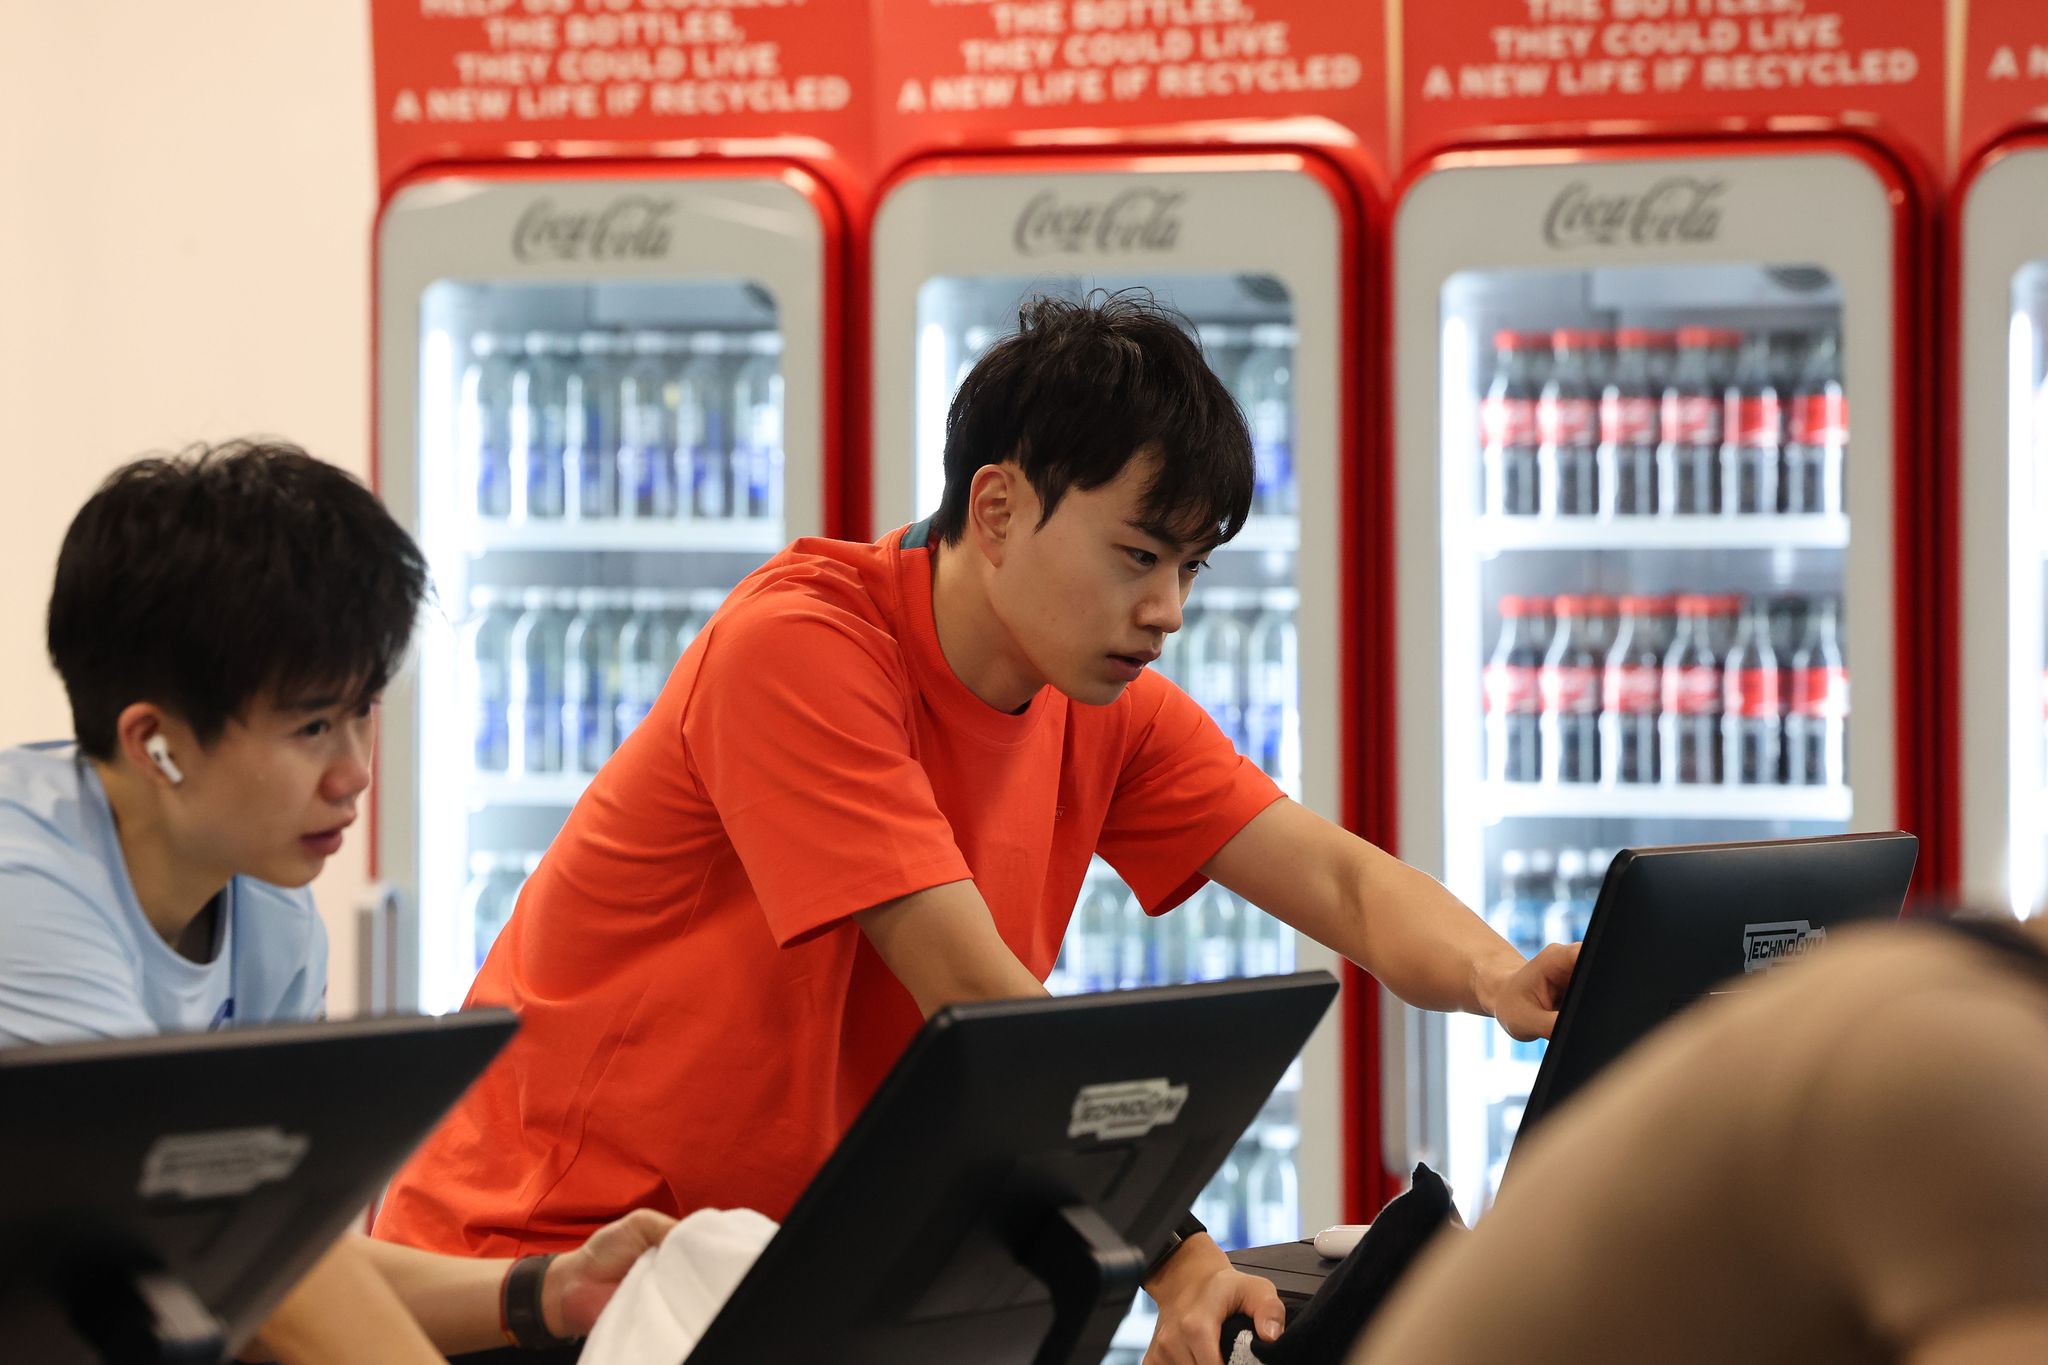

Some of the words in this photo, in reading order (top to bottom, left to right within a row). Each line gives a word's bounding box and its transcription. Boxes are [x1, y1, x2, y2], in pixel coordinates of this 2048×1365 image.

[484, 17, 560, 49] THE
[991, 3, 1065, 36] THE
[1490, 25, 1597, 59] THEY
[1602, 18, 1740, 56] COULD
[1748, 12, 1843, 51] LIVE
[454, 50, 551, 84] THEY
[556, 45, 687, 82] COULD
[692, 41, 780, 78] LIVE
[960, 37, 1057, 71] THEY
[1063, 29, 1195, 66] COULD
[1200, 20, 1288, 58] LIVE
[1985, 46, 2020, 81] A
[897, 78, 926, 114] A
[930, 74, 1017, 111] NEW
[1021, 69, 1106, 107] LIFE
[1112, 66, 1152, 101] IF
[1157, 53, 1362, 98] RECYCLED
[1420, 65, 1453, 100] A
[1458, 62, 1550, 99] NEW
[1556, 58, 1646, 97] LIFE
[1653, 56, 1694, 93] IF
[1702, 47, 1920, 90] RECYCLED
[393, 89, 422, 124] A
[426, 87, 512, 122] NEW
[518, 85, 600, 120] LIFE
[605, 82, 646, 118] IF
[649, 74, 852, 116] RECYCLED
